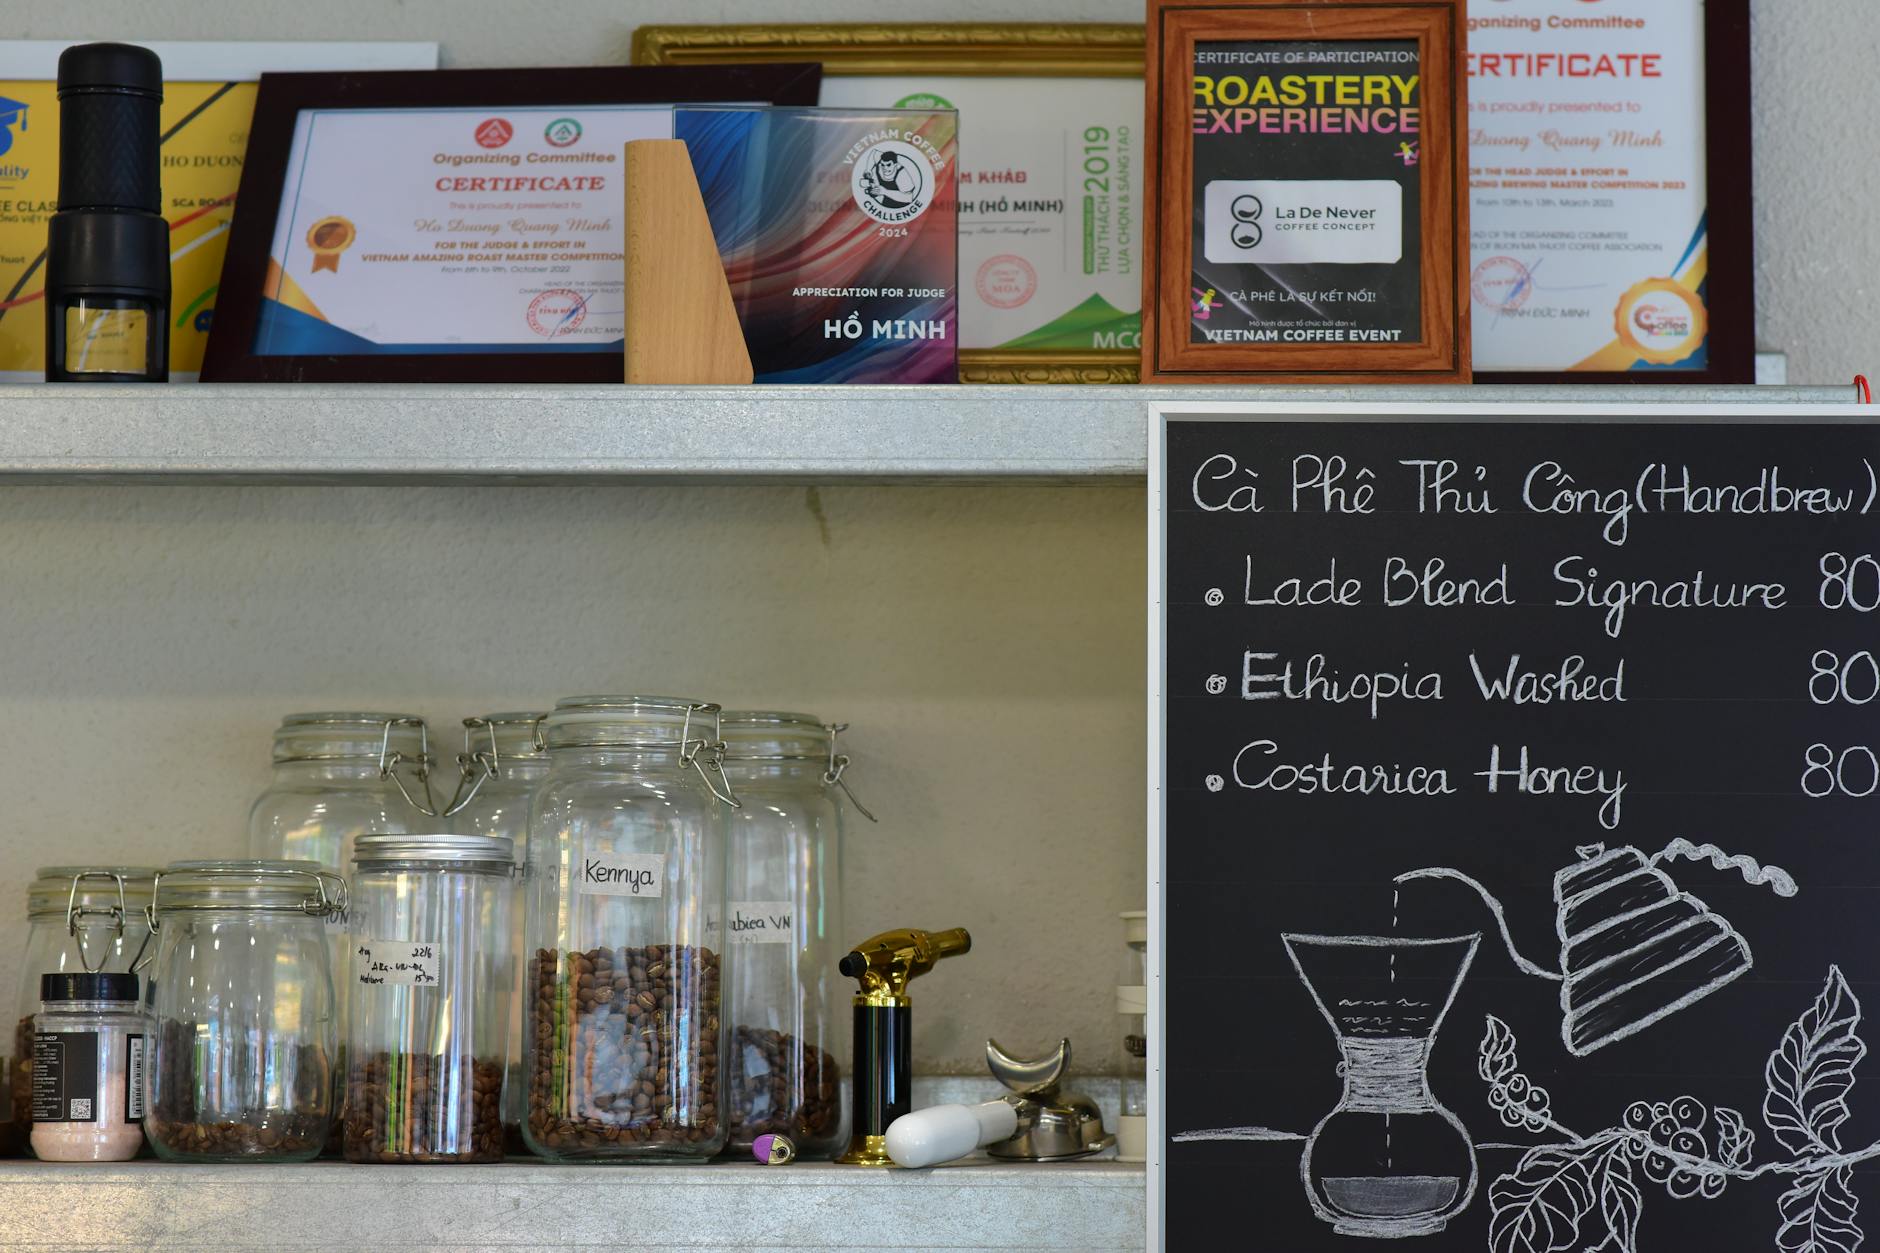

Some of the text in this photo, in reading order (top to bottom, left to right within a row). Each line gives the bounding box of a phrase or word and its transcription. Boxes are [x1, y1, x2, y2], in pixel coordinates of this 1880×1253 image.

[1547, 15, 1645, 30] Committee
[1284, 52, 1304, 64] OF
[1308, 51, 1420, 64] PARTICIPATION
[1193, 75, 1420, 106] ROASTERY
[1548, 101, 1615, 115] presented
[1193, 107, 1420, 134] EXPERIENCE
[1608, 130, 1664, 147] Minh
[843, 129, 946, 171] VIETNAM COFFEE
[433, 152, 616, 166] Organizing Committee
[1084, 126, 1109, 193] 2019
[435, 176, 606, 191] CERTIFICATE
[863, 200, 923, 221] CHALLENGE
[1012, 199, 1064, 214] MINH)
[1275, 206, 1376, 219] La De Never
[879, 227, 908, 238] 2024
[1275, 223, 1376, 231] COFFEE CONCEPT
[435, 241, 586, 249] FOR THE JUDGE & EFFORT IN
[361, 252, 625, 262] VIETNAM AMAZING ROAST MASTER COMPETITION
[792, 287, 945, 298] APPRECIATION FOR JUDGE
[824, 310, 946, 339] HỒ MINH
[1205, 329, 1402, 342] VIETNAM COFFEE EVENT
[1193, 454, 1264, 513] Cà
[1292, 454, 1376, 514] Phê
[1398, 459, 1499, 513] Thủ
[1245, 552, 1880, 638] Lade Blend Signature 80
[1241, 645, 1880, 719] Ethiopia Washed 80
[1233, 740, 1879, 829] Costarica Honey 80
[584, 858, 655, 894] Kennya
